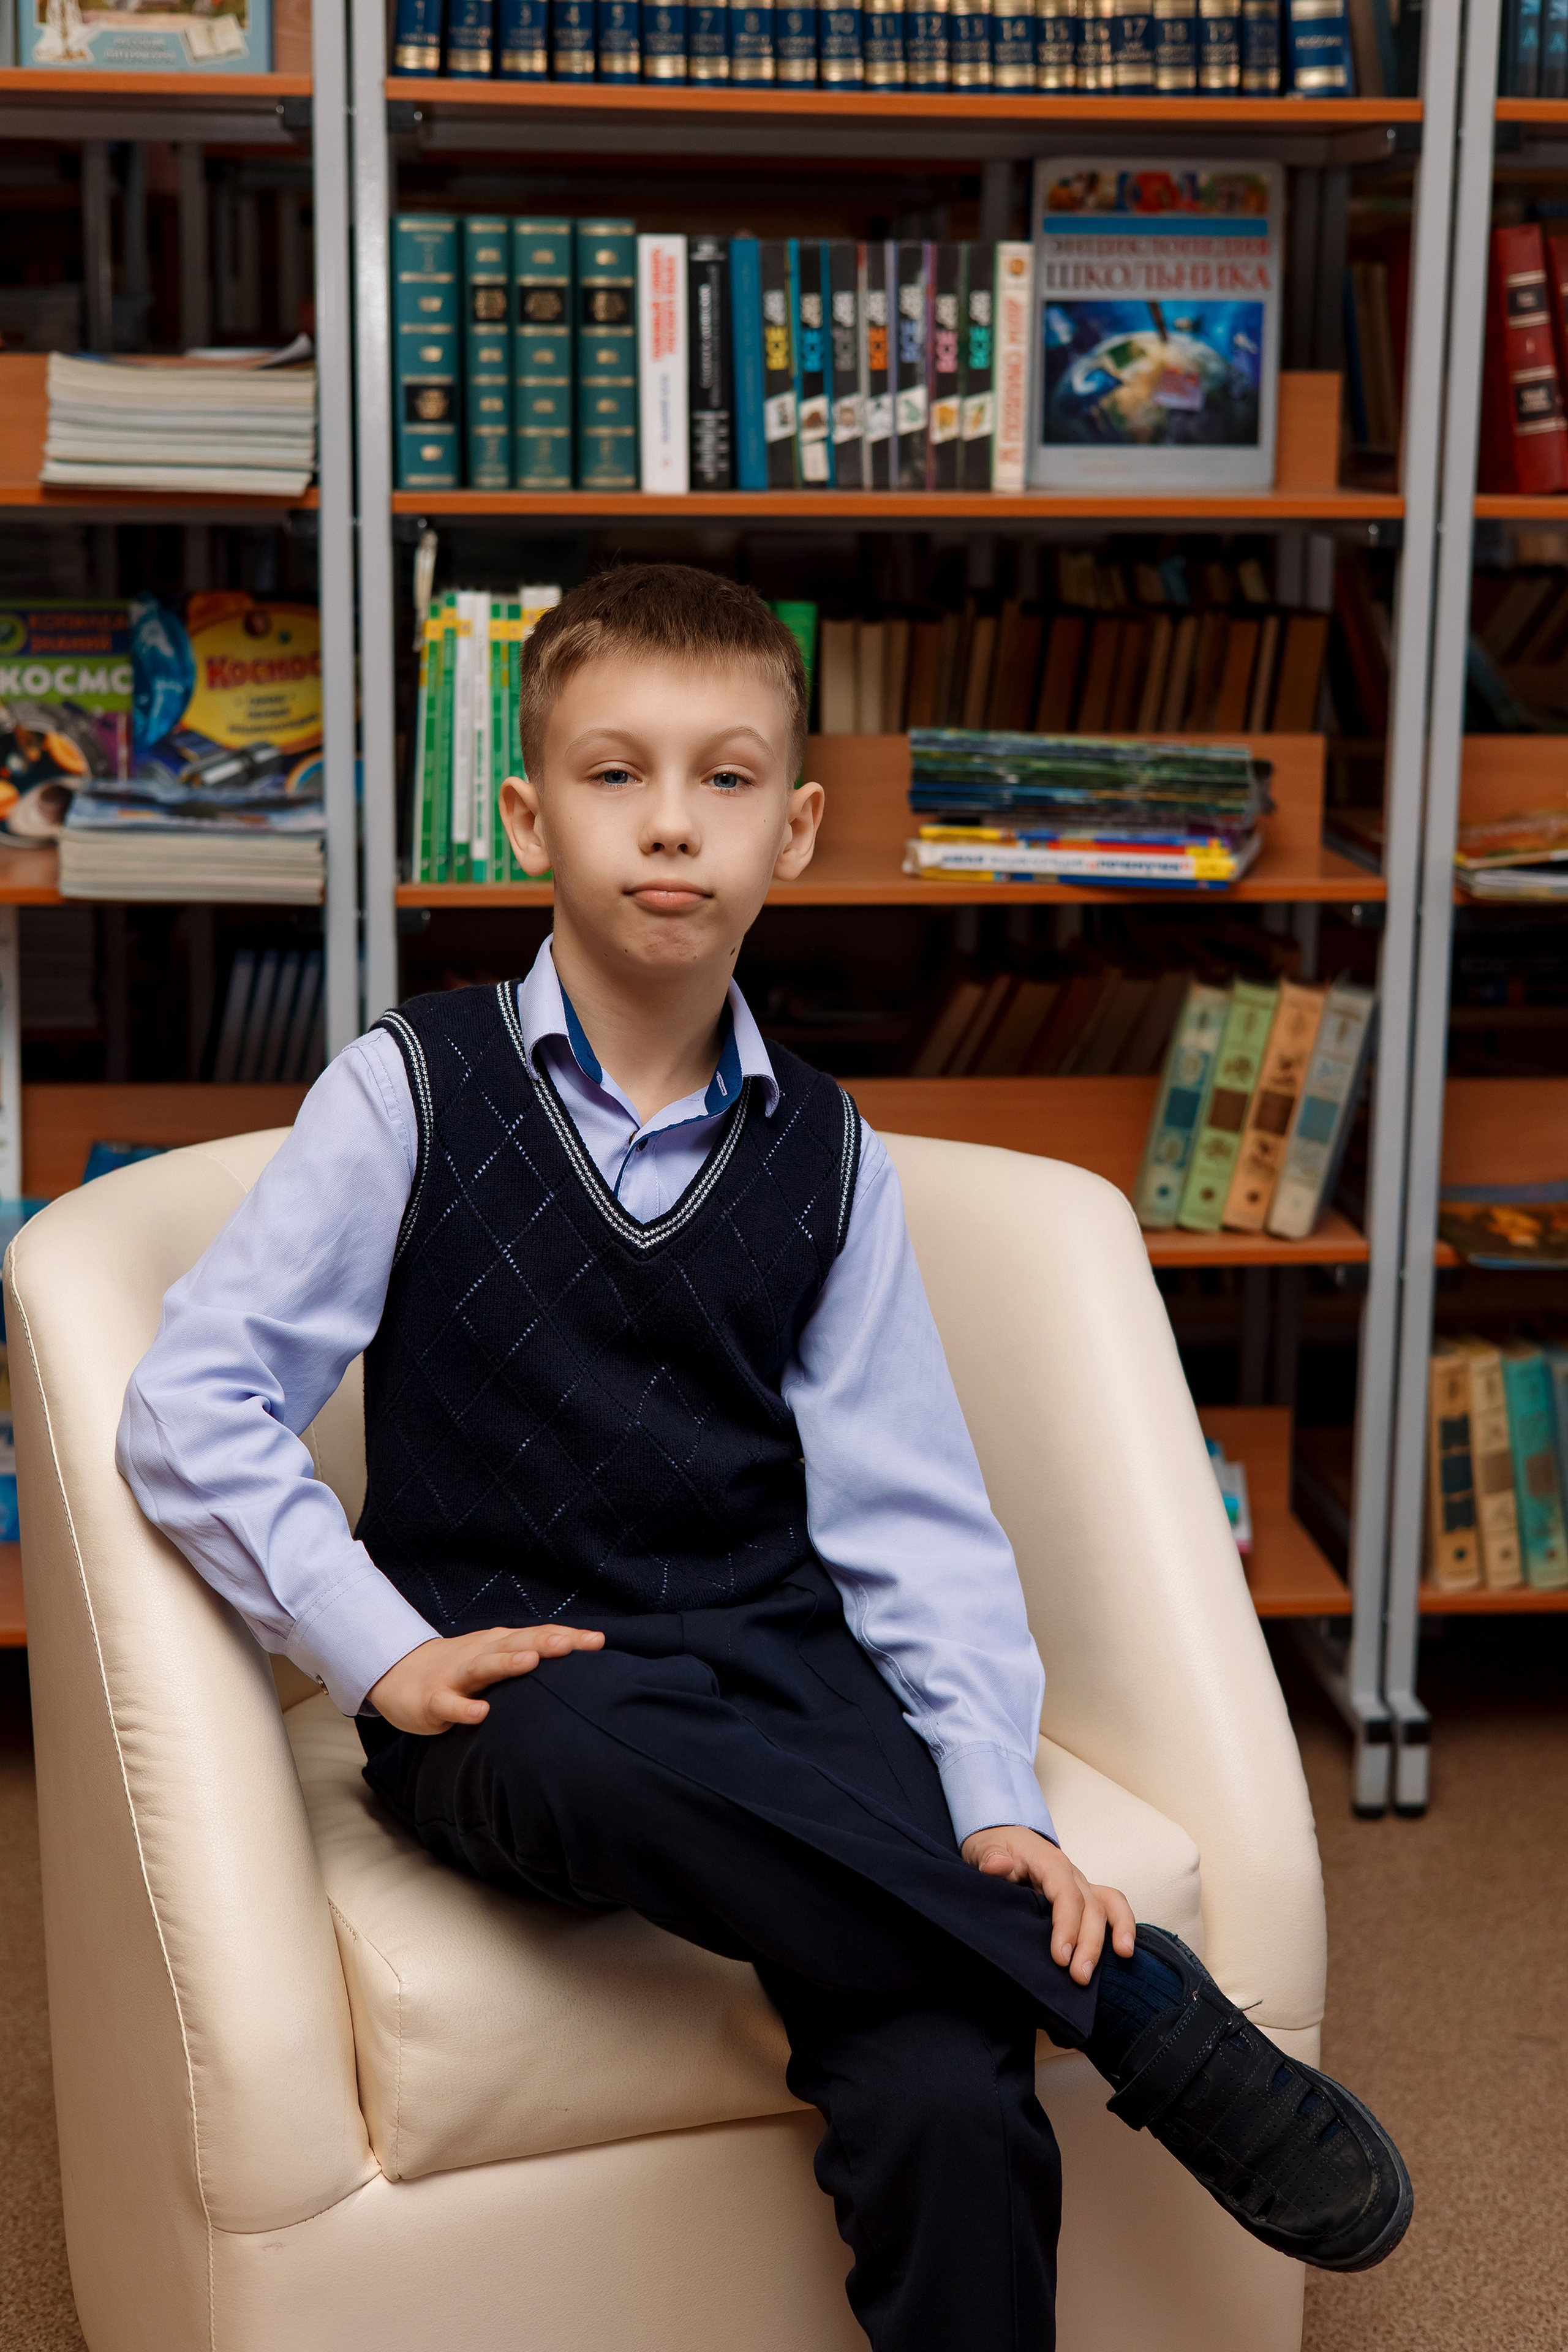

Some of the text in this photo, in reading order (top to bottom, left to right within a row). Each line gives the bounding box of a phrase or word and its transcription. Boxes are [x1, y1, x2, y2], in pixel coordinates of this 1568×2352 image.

[464, 2, 478, 26] 2
[565, 4, 580, 26] 4
[612, 4, 625, 28] 5
[657, 9, 671, 31] 6
[699, 10, 714, 33] 7
[744, 11, 760, 33] 8
[788, 12, 802, 35] 9
[829, 12, 854, 34] 10
[870, 15, 894, 37] 11
[916, 15, 941, 37] 12
[957, 17, 984, 39] 13
[1001, 19, 1026, 41] 14
[1044, 19, 1069, 42] 15
[1083, 20, 1110, 42] 16
[1123, 17, 1148, 40] 17
[1163, 21, 1187, 43] 18
[1207, 20, 1233, 42] 19
[1045, 262, 1271, 292] ШКОЛЬНИКА
